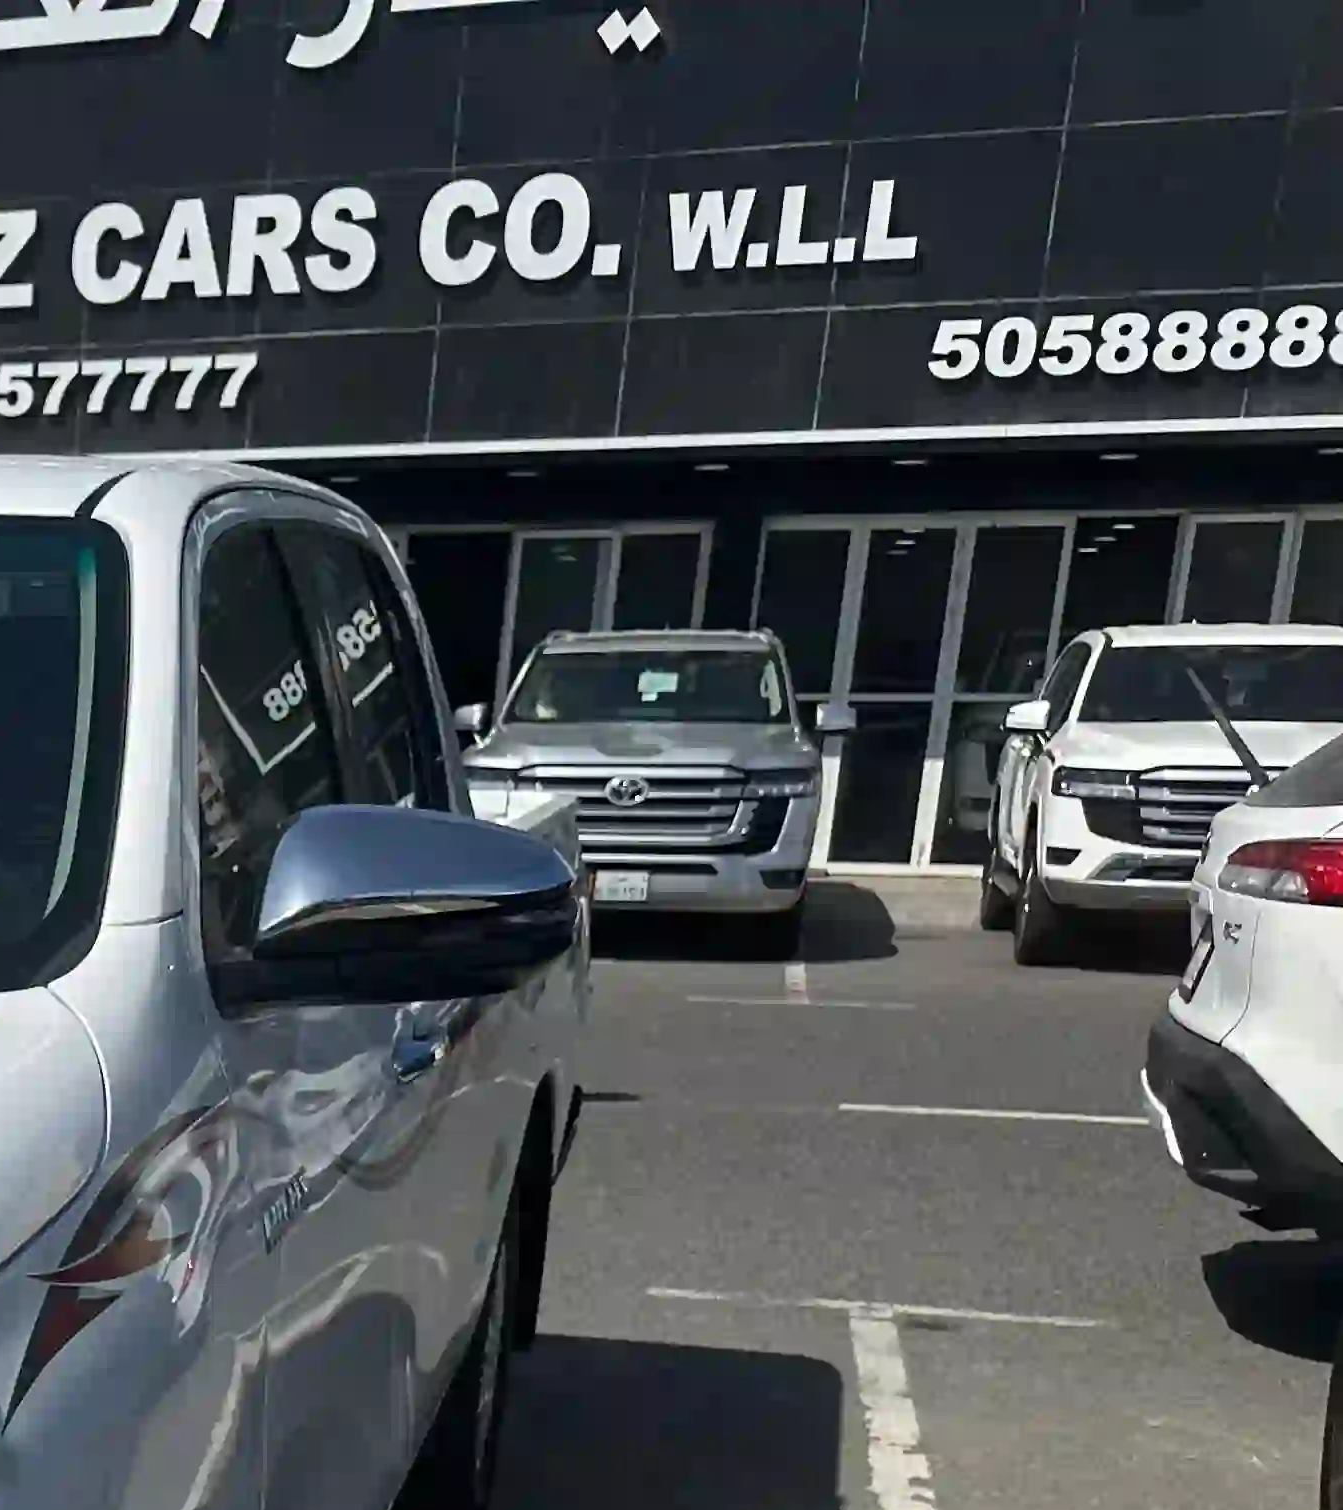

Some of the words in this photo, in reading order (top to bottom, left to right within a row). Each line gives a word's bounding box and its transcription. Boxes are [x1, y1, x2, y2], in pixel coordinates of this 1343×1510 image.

[71, 187, 377, 304] CARS
[419, 173, 622, 286] CO.
[669, 179, 918, 271] W.L.L
[928, 304, 1343, 380] 5058888
